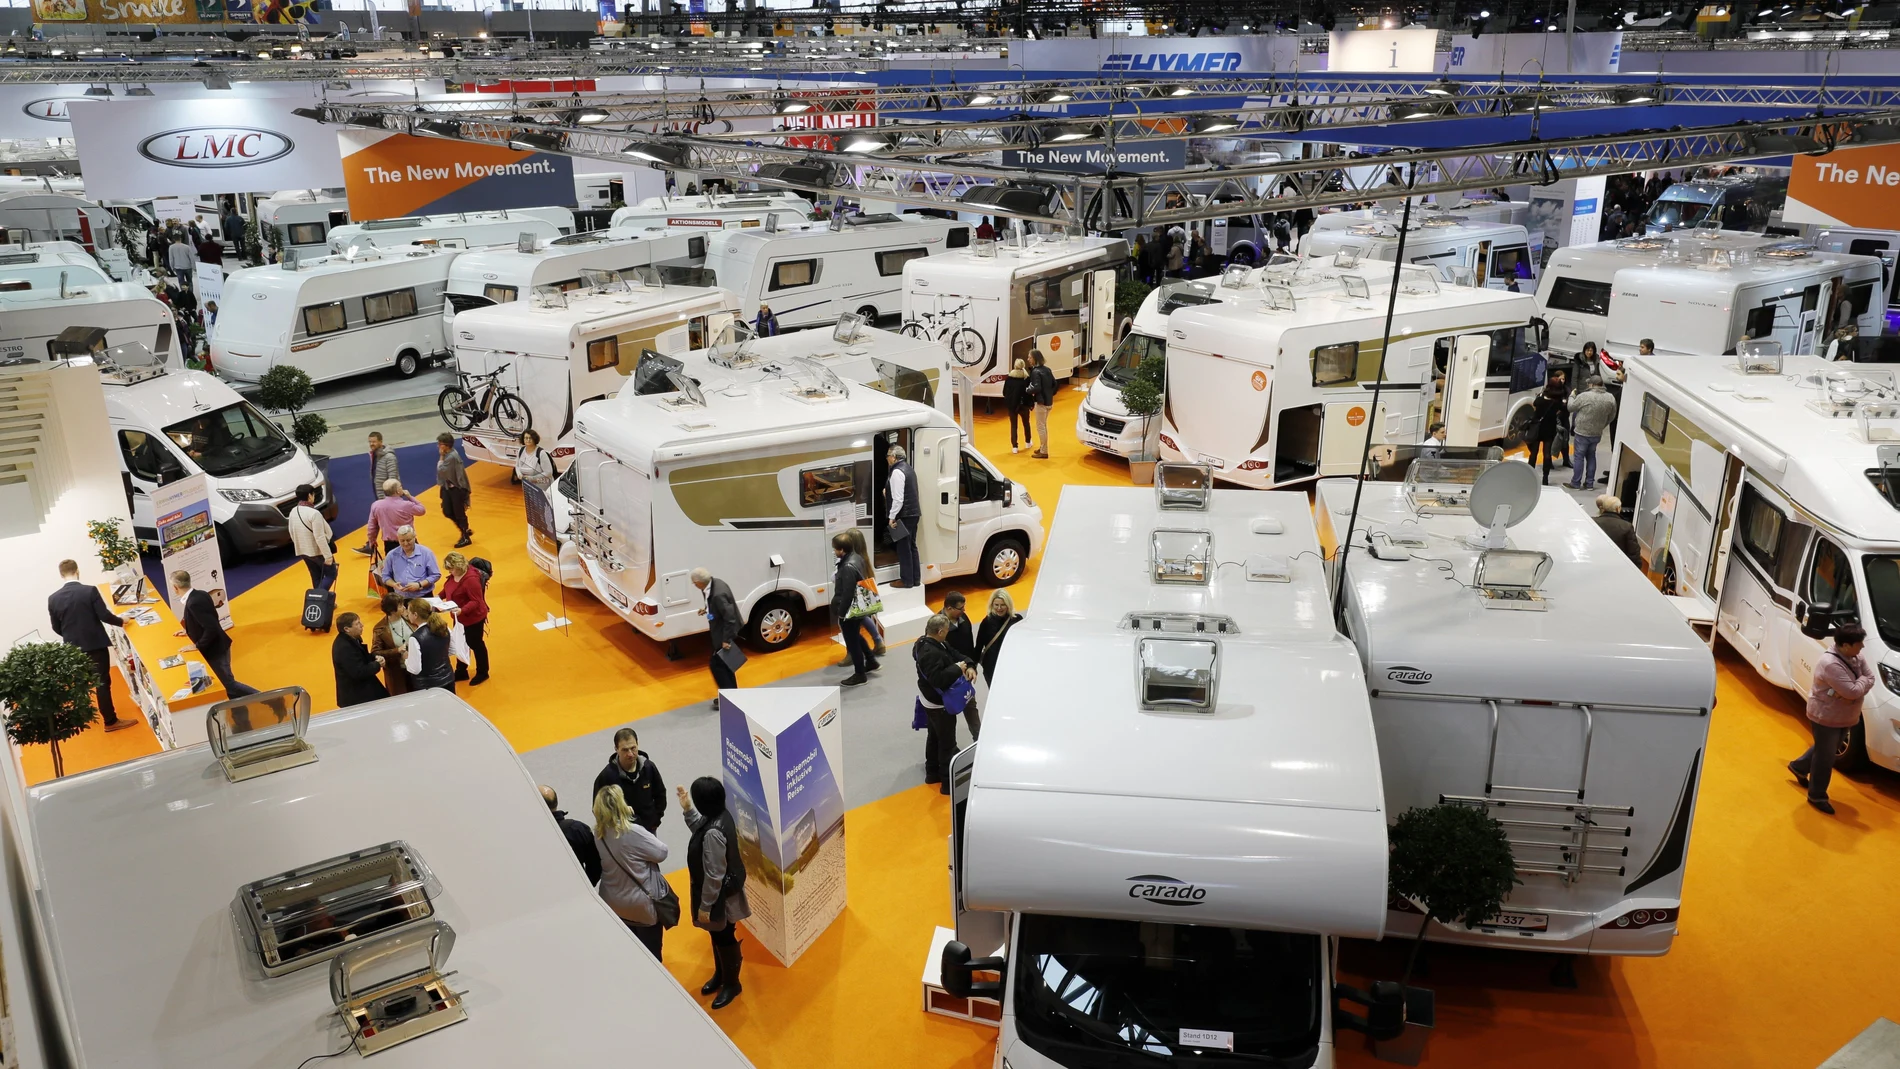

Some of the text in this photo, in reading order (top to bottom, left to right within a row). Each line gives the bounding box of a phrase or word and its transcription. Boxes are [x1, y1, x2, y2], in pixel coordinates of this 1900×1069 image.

[46, 101, 69, 117] L
[174, 133, 262, 161] LMC
[1016, 149, 1170, 164] The New Movement.
[364, 159, 556, 184] The New Movement.
[1815, 162, 1859, 184] The
[726, 737, 754, 767] Reisemobil
[726, 747, 748, 773] inklusive
[726, 757, 742, 777] Reise.
[785, 747, 818, 780] Reisemobil
[786, 765, 812, 791] inklusive
[787, 784, 805, 802] Reise.
[1502, 915, 1526, 925] 337
[1202, 1033, 1218, 1041] 1D12
